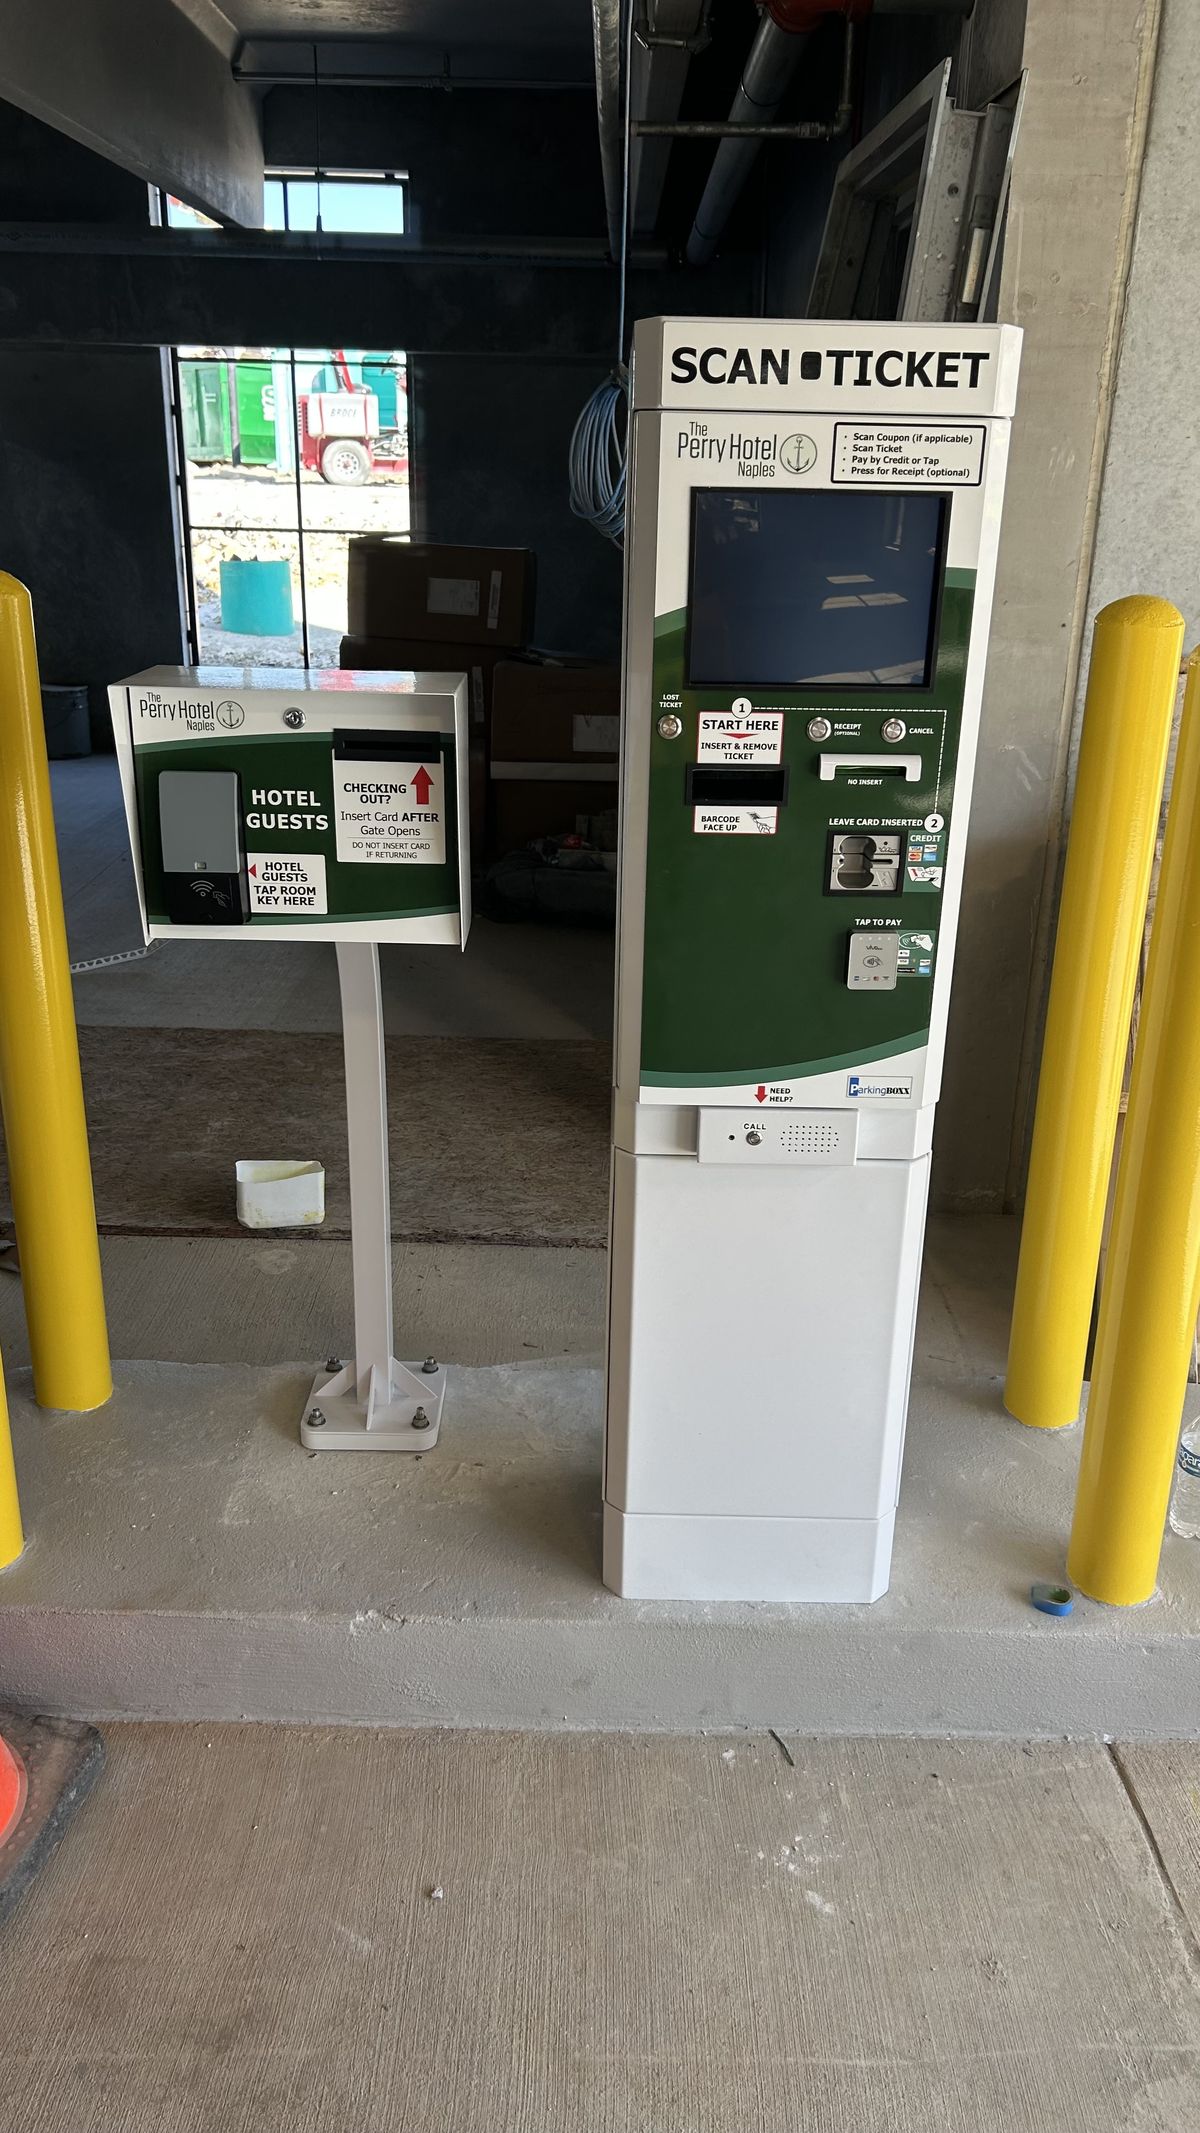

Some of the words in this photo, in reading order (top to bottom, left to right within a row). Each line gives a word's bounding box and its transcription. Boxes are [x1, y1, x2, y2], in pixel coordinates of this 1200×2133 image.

[671, 347, 789, 384] SCAN
[826, 350, 990, 388] TICKET
[689, 421, 708, 436] The
[853, 433, 874, 441] Scan
[877, 433, 910, 443] Coupon
[912, 434, 923, 444] (if
[924, 434, 973, 444] applicable)
[678, 432, 727, 463] Perry
[730, 433, 777, 460] Hotel
[852, 444, 873, 452] Scan
[876, 445, 903, 453] Ticket
[852, 456, 868, 465] Pay
[870, 456, 881, 465] by
[883, 456, 909, 465] Credit
[923, 457, 939, 465] Tap
[738, 461, 775, 479] Naples
[851, 467, 875, 475] Press
[877, 467, 889, 475] for
[892, 467, 925, 477] Receipt
[926, 468, 970, 478] (optional)
[146, 692, 161, 702] The
[140, 699, 176, 721] Perry
[178, 700, 214, 719] Hotel
[739, 703, 745, 713] 1
[186, 719, 215, 732] Naples
[702, 720, 742, 730] START
[746, 721, 779, 730] HERE
[701, 742, 732, 750] INSERT
[724, 752, 754, 760] TICKET
[343, 783, 407, 793] CHECKING
[251, 789, 321, 806] HOTEL
[360, 794, 391, 804] OUT?
[246, 813, 329, 830] GUESTS
[341, 811, 371, 821] Insert
[374, 812, 398, 821] Card
[401, 813, 440, 822] AFTER
[701, 815, 740, 823] BARCODE
[829, 818, 855, 826] LEAVE
[880, 819, 923, 827] INSERTED
[930, 819, 938, 828] 2
[360, 825, 385, 835] Gate
[387, 826, 421, 837] Opens
[375, 851, 418, 859] RETURNING
[265, 862, 304, 871] HOTEL
[262, 872, 308, 882] GUESTS
[254, 885, 276, 895] TAP
[280, 886, 316, 895] ROOM
[257, 896, 279, 905] KEY
[284, 896, 315, 906] HERE
[849, 1083, 910, 1096] ParkingBOXX
